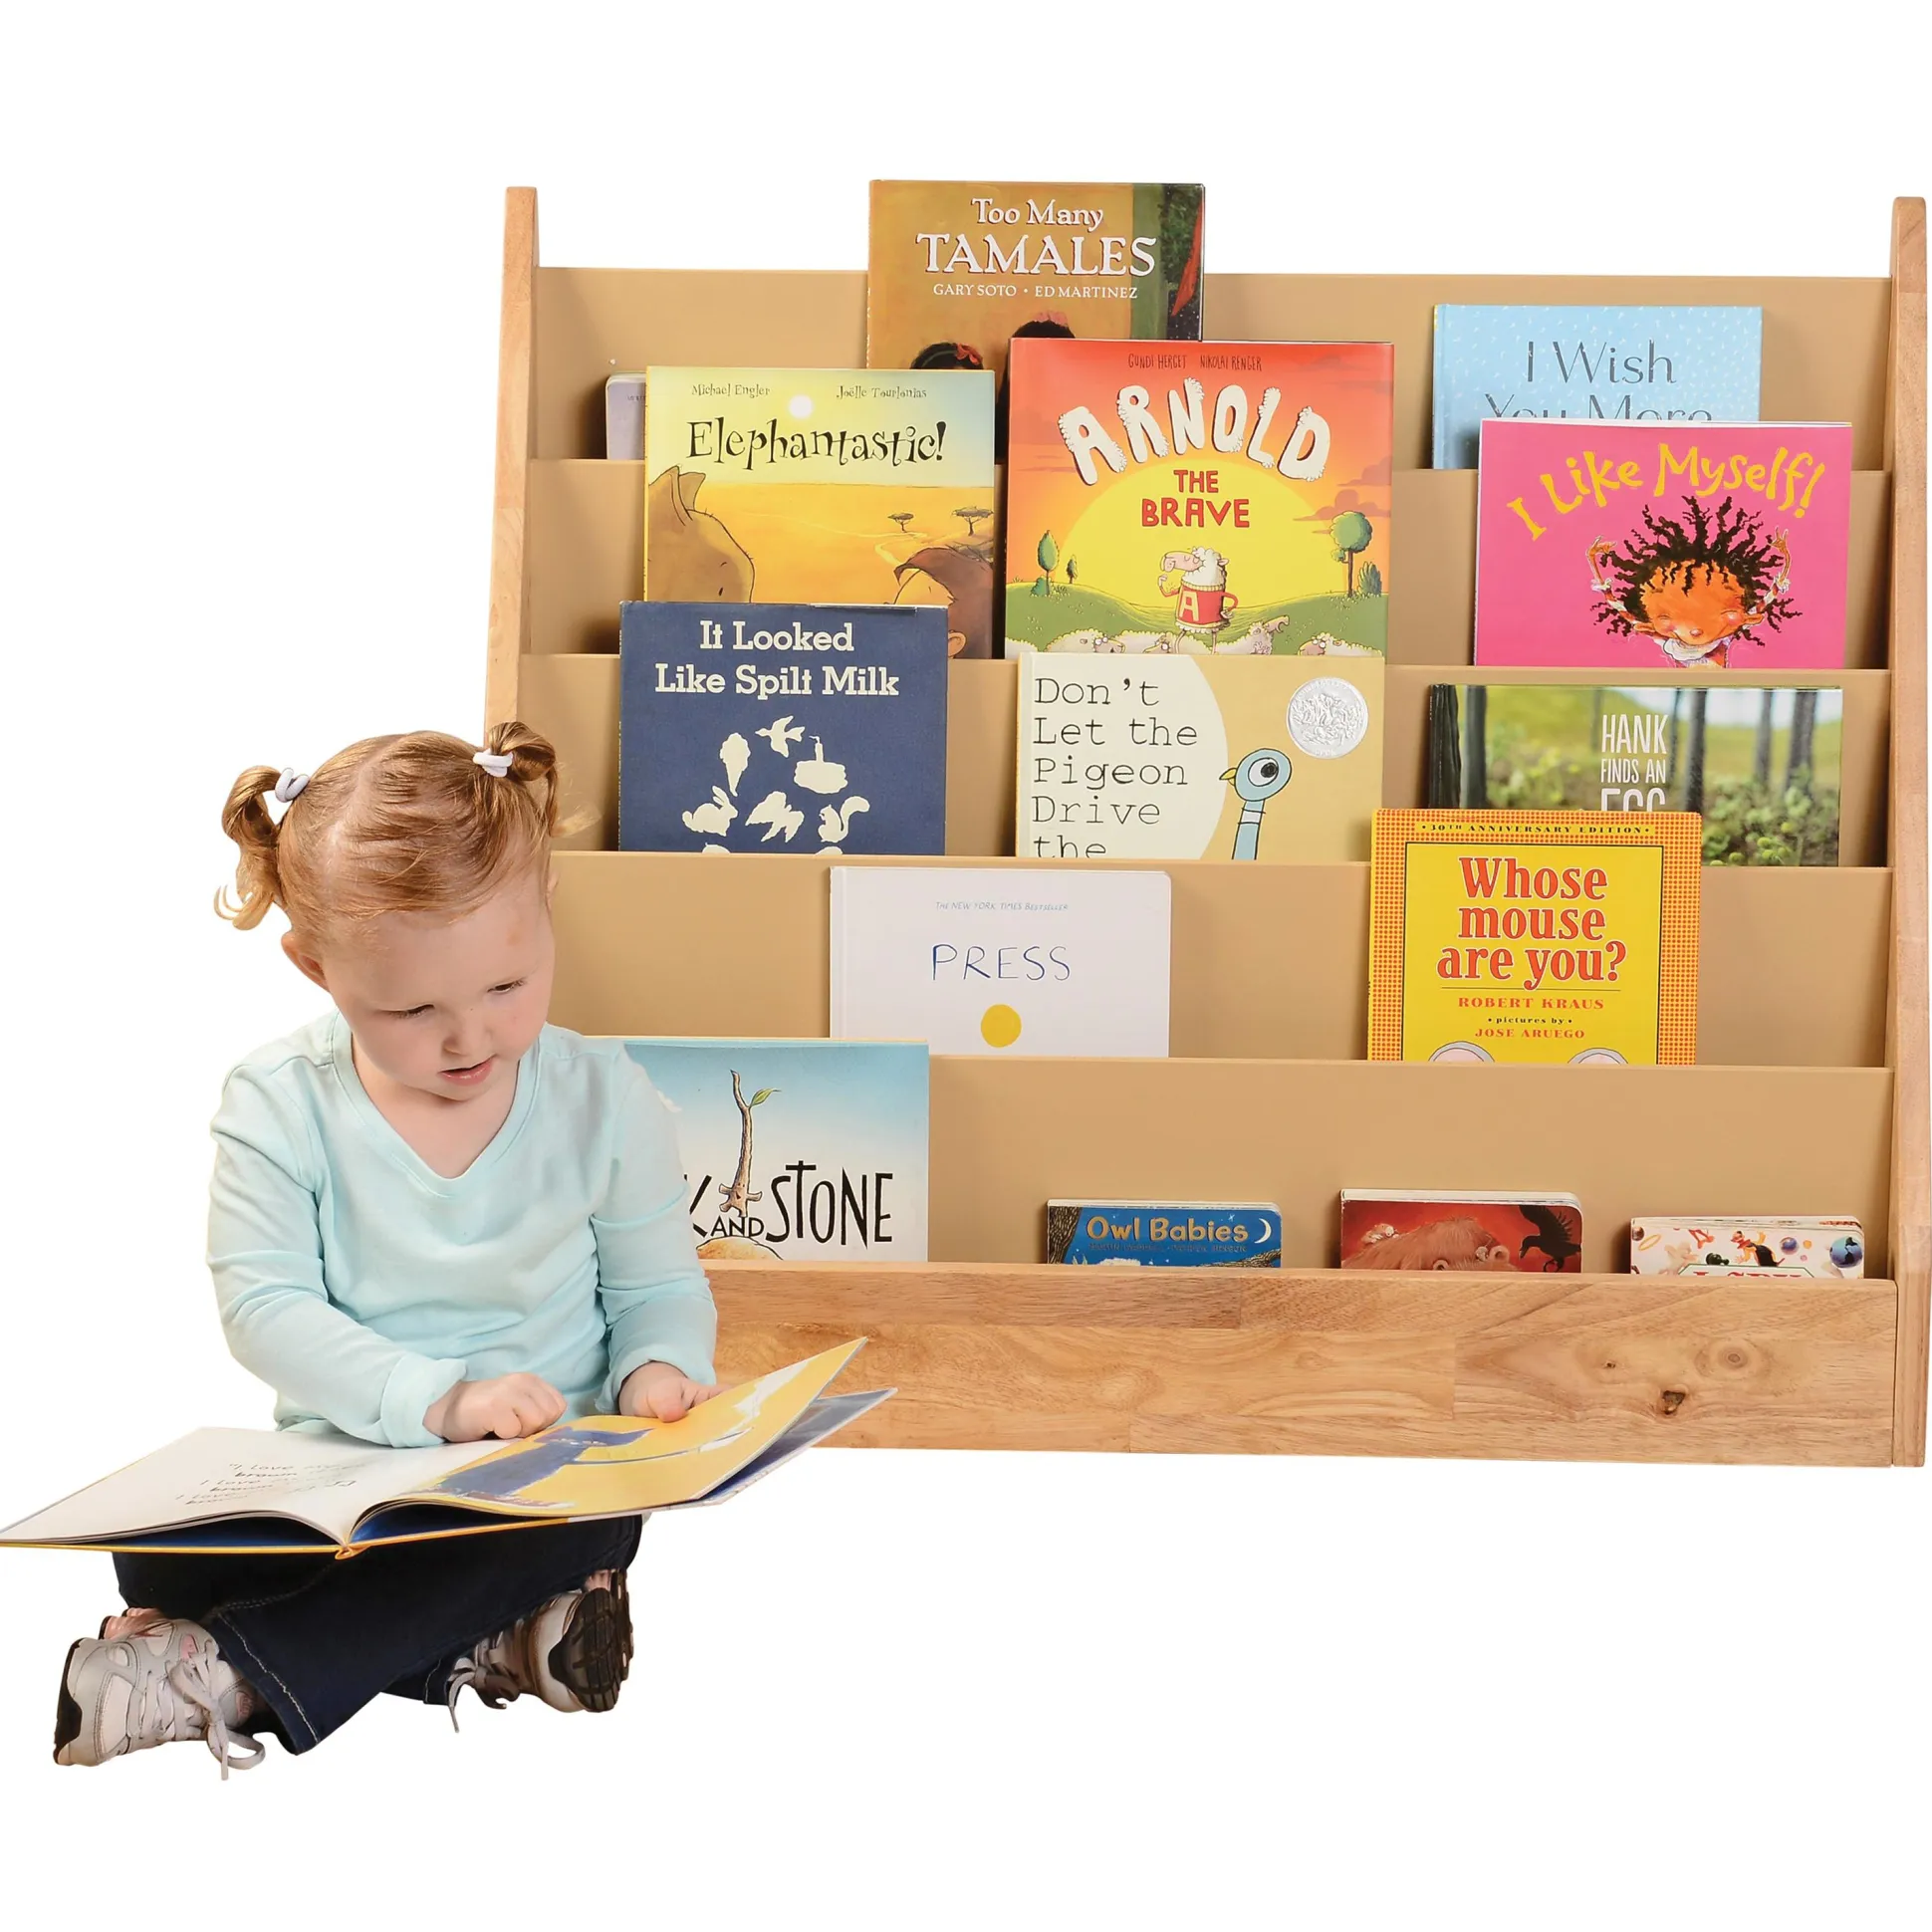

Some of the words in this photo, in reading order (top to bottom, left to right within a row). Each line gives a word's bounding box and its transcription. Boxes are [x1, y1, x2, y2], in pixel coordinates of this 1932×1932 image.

[971, 198, 1020, 224] Too
[1026, 198, 1103, 232] Many
[915, 233, 1157, 277] TAMALES
[932, 283, 975, 297] GARY
[976, 283, 1017, 298] SOTO
[1034, 285, 1056, 298] ED
[1058, 286, 1138, 300] MARTINEZ
[1527, 341, 1535, 383] I
[1552, 340, 1678, 384] Wish
[691, 382, 731, 396] Michael
[735, 383, 771, 398] Engler
[685, 416, 948, 471] Elephantastic!
[1058, 376, 1331, 487] ARNOLD
[1173, 468, 1220, 494] THE
[1506, 496, 1548, 542] I
[1540, 450, 1643, 515] Like
[1652, 442, 1826, 519] Myself!
[1140, 497, 1251, 529] BRAVE
[699, 619, 723, 649] It
[732, 620, 854, 652] Looked
[653, 662, 726, 694] Like
[735, 664, 813, 700] Spilt
[822, 665, 900, 696] Milk
[1033, 716, 1106, 746] Let
[1127, 716, 1198, 747] the
[1600, 713, 1669, 755] HANK
[1033, 755, 1189, 791] Pigeon
[1600, 758, 1640, 785] FINDS
[1645, 758, 1667, 785] AN
[1031, 795, 1161, 825] Drive
[1468, 825, 1572, 834] ANNIVERSARY
[1032, 835, 1106, 858] the
[1458, 855, 1609, 901] Whose
[1457, 905, 1607, 942] mouse
[932, 942, 1072, 981] PRESS
[1435, 945, 1515, 981] are
[1522, 939, 1628, 993] you?
[1458, 997, 1534, 1008] ROBERT
[1542, 998, 1604, 1010] KRAUS
[1474, 1028, 1515, 1039] JOSE
[1521, 1028, 1585, 1040] ARUEGO
[1496, 1015, 1548, 1025] pictures
[1551, 1016, 1566, 1026] by
[710, 1215, 765, 1238] AND
[765, 1160, 893, 1250] STONE
[1086, 1216, 1141, 1241] Owl
[1148, 1216, 1250, 1243] Babies
